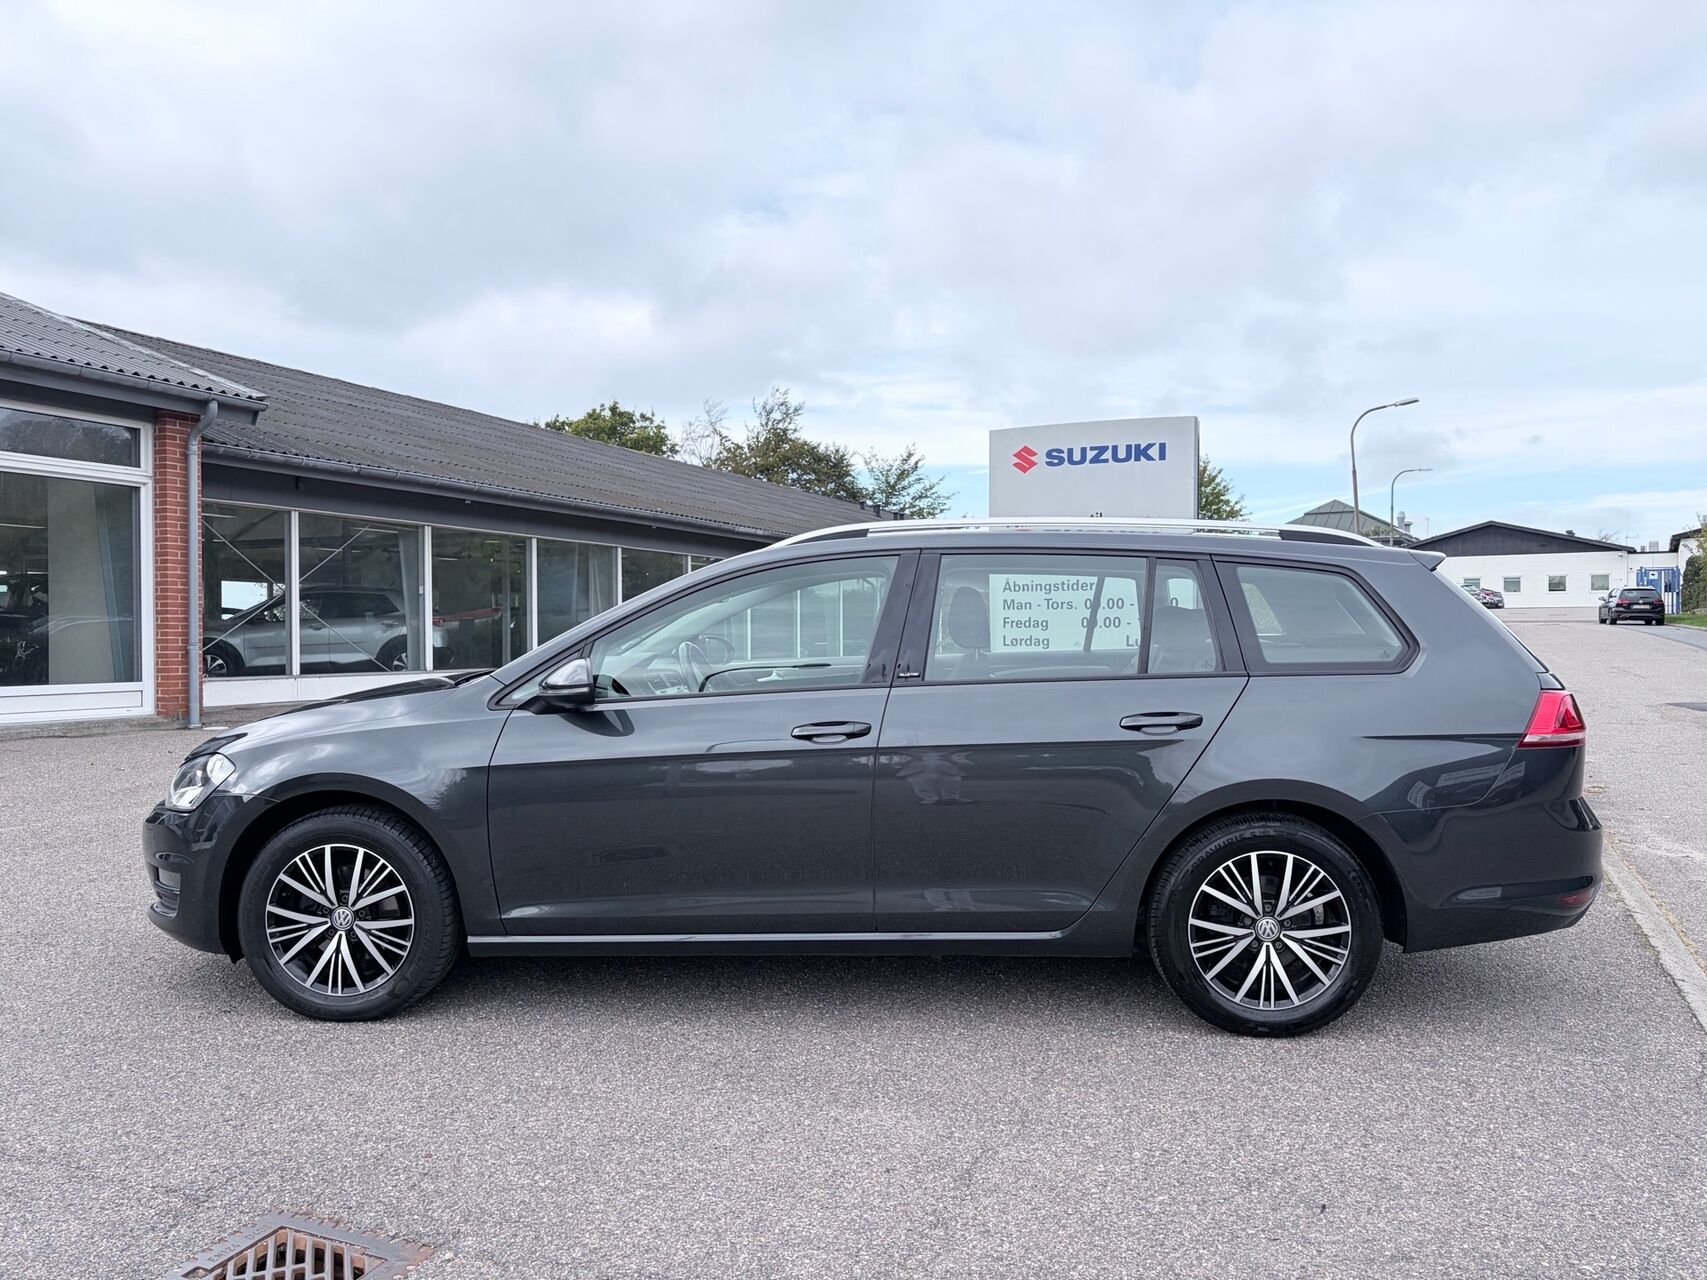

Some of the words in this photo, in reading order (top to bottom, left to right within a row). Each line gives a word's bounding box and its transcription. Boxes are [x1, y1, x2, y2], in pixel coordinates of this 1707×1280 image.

[1045, 442, 1167, 467] SUZUKI
[1003, 577, 1096, 595] Åbningstider
[1003, 599, 1032, 610] Man
[1044, 598, 1077, 610] Tors.
[1084, 598, 1125, 610] 0.00
[1003, 617, 1049, 631] Fredag
[1081, 616, 1121, 628] 0.00
[1003, 635, 1050, 649] Lørdag
